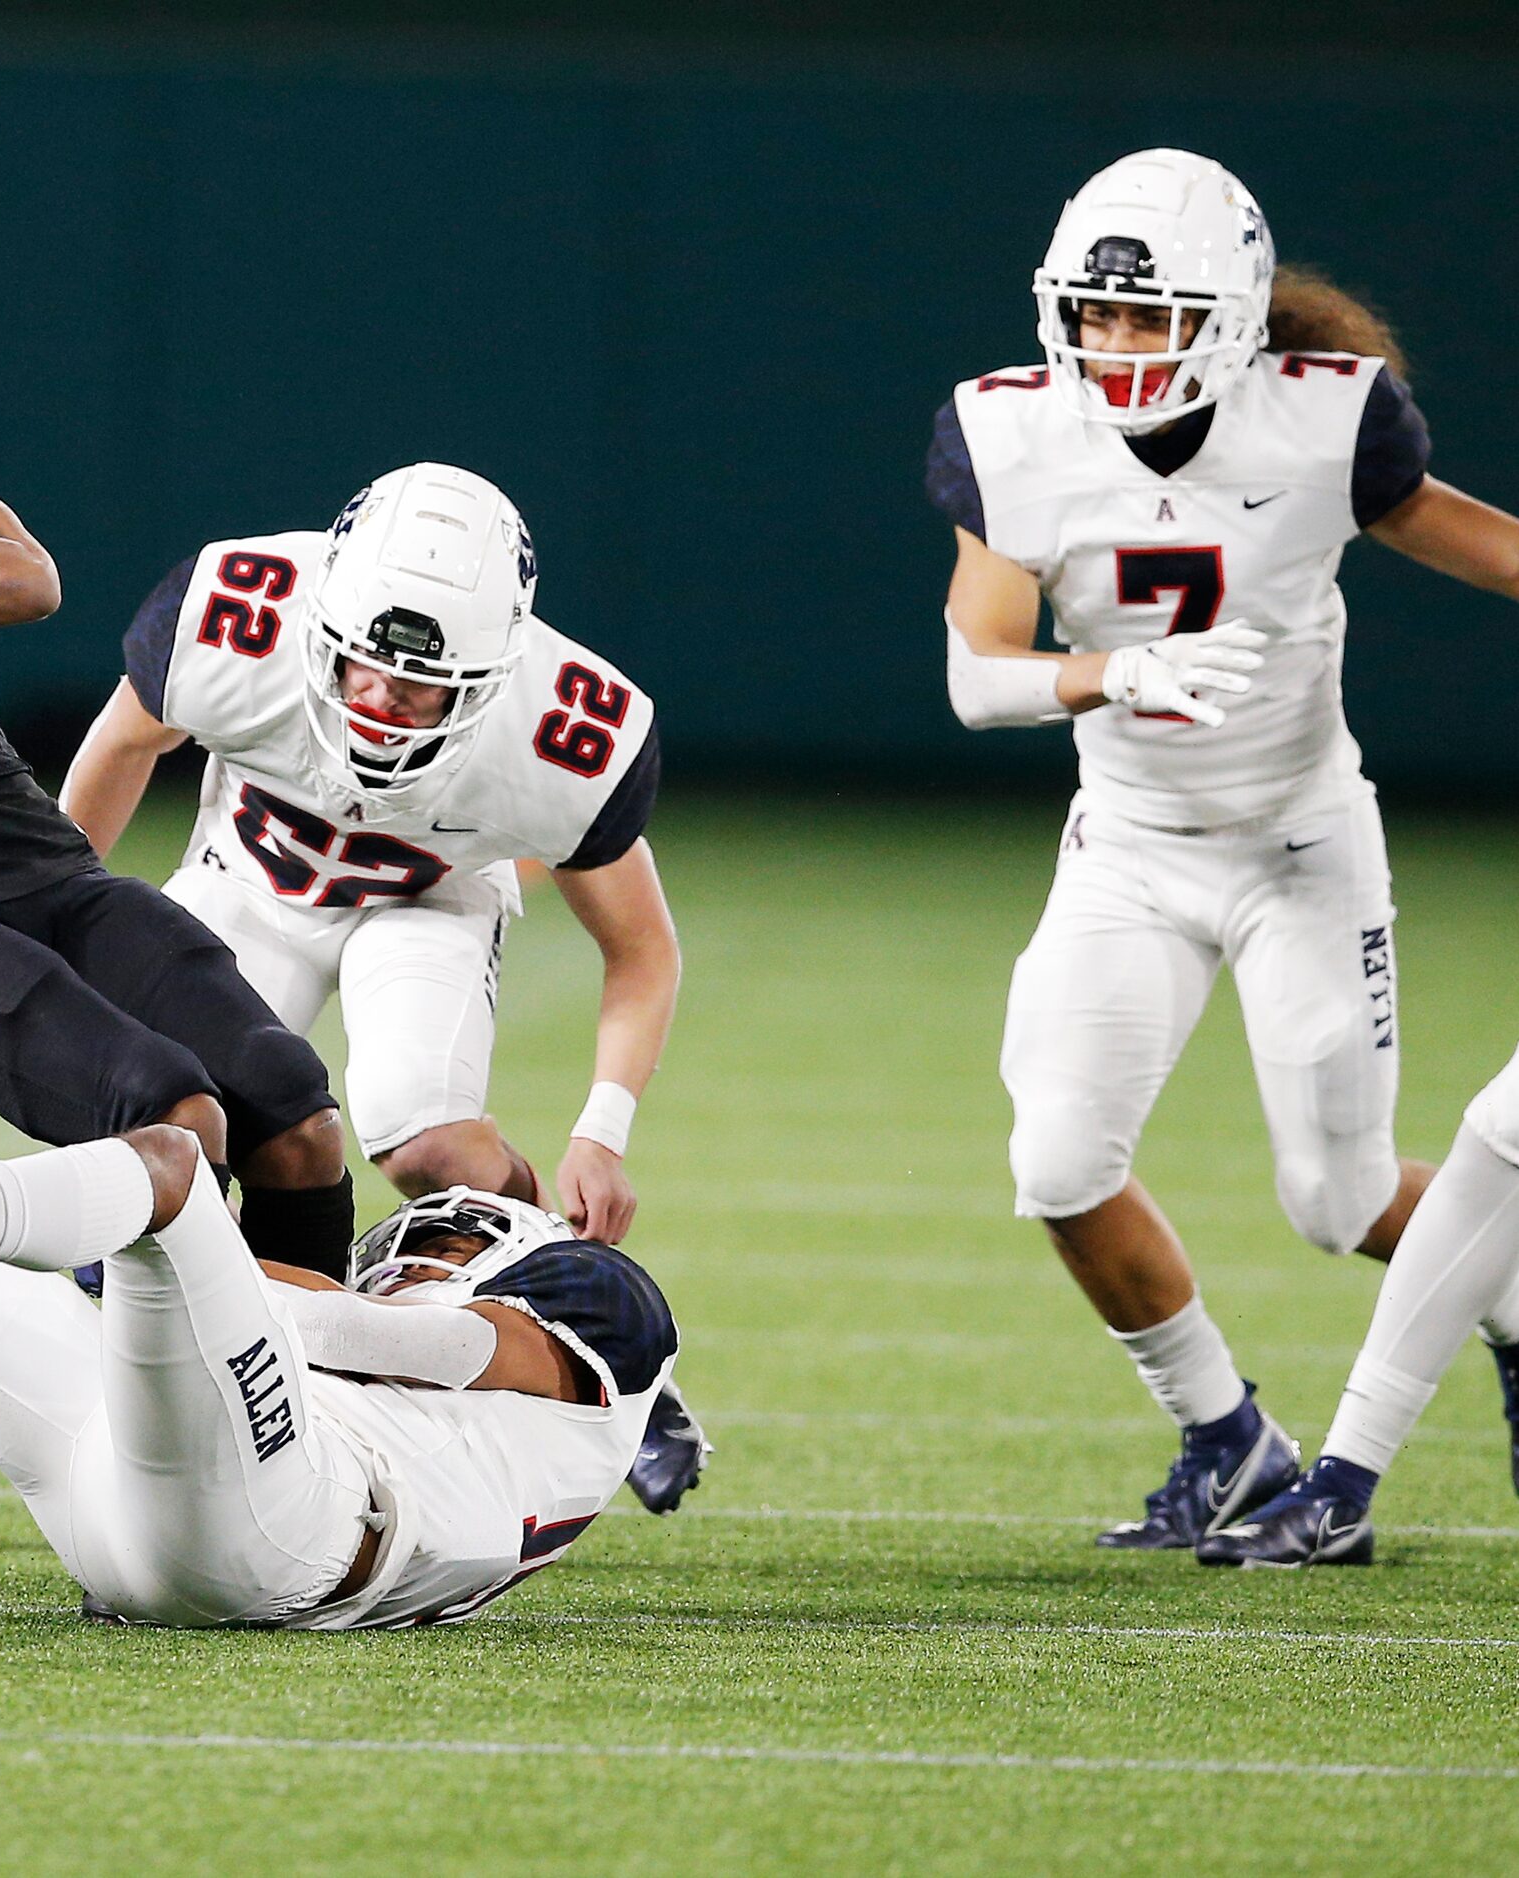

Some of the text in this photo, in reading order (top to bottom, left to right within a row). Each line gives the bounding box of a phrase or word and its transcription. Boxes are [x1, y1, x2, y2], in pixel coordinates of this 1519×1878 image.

[1155, 498, 1177, 521] A
[197, 551, 298, 659] 62
[1115, 545, 1225, 724] 7
[532, 661, 632, 779] 62
[225, 1336, 297, 1463] ALLEN
